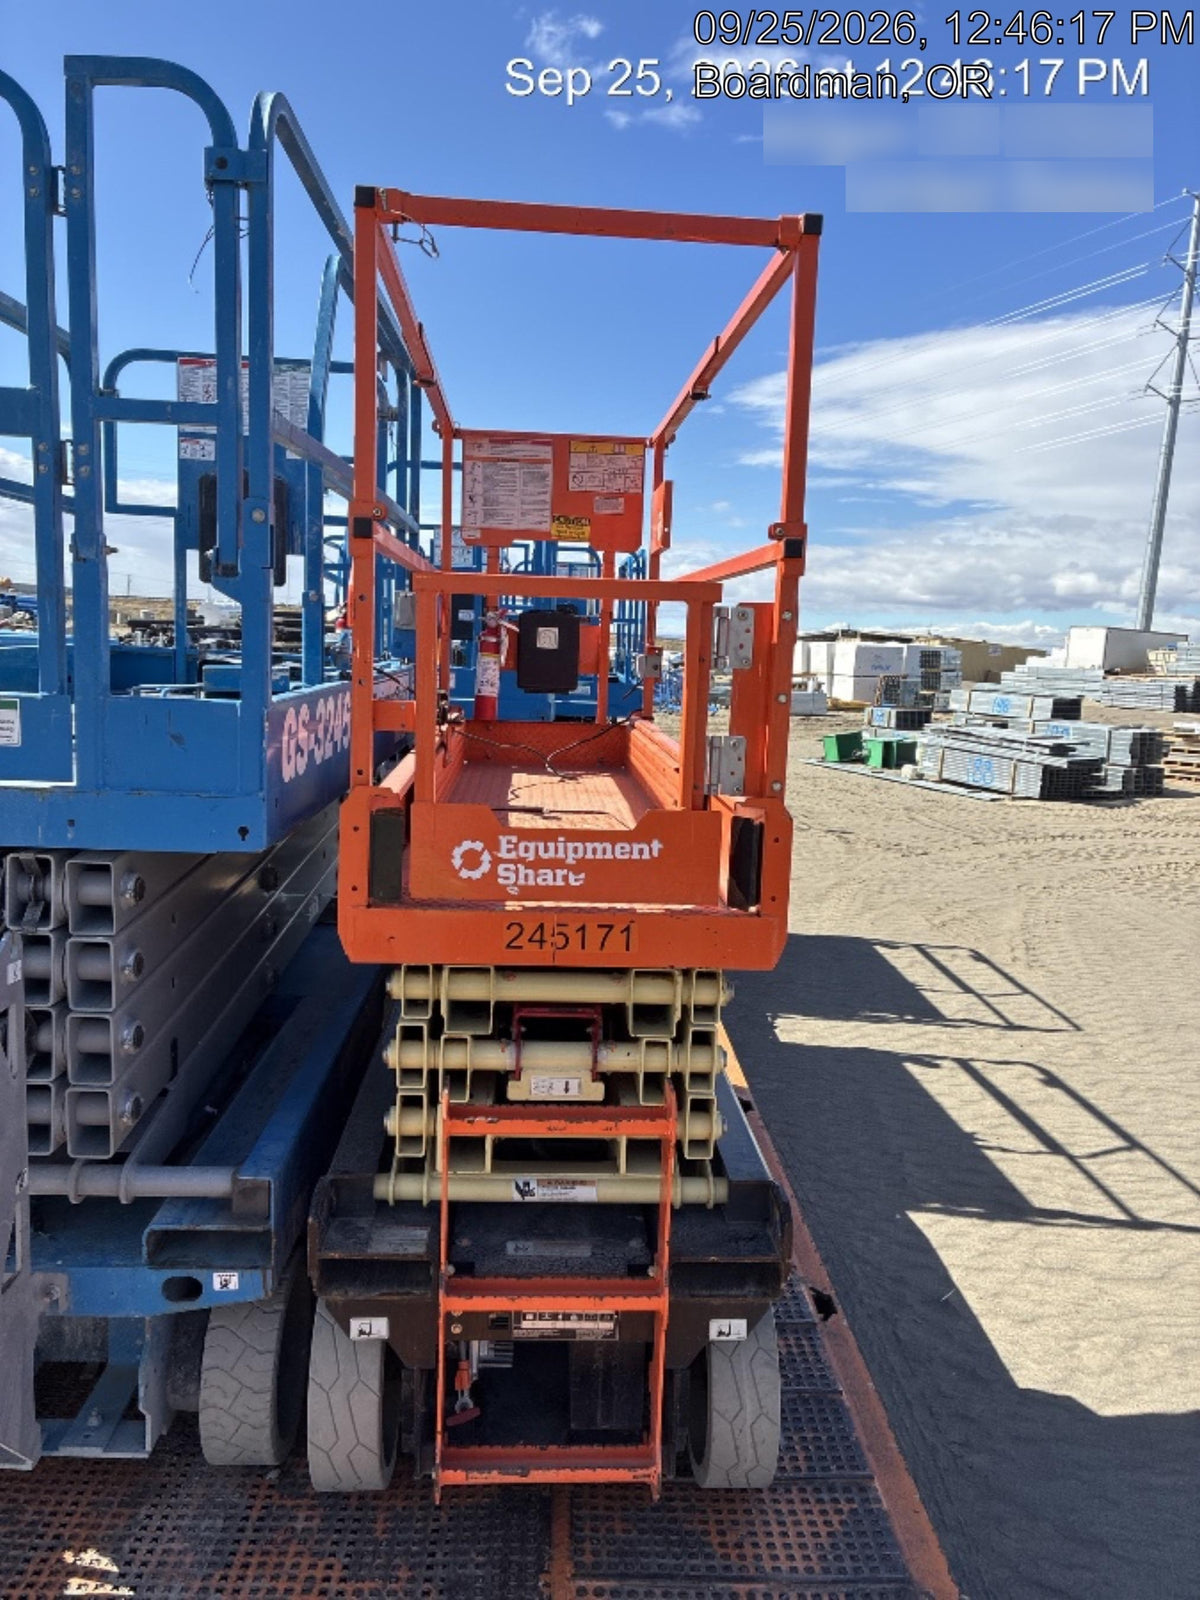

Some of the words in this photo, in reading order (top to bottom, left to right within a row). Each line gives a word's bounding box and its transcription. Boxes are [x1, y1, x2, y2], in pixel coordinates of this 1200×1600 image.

[495, 835, 663, 865] Equipment
[497, 863, 585, 888] Share
[505, 920, 635, 952] 245171
